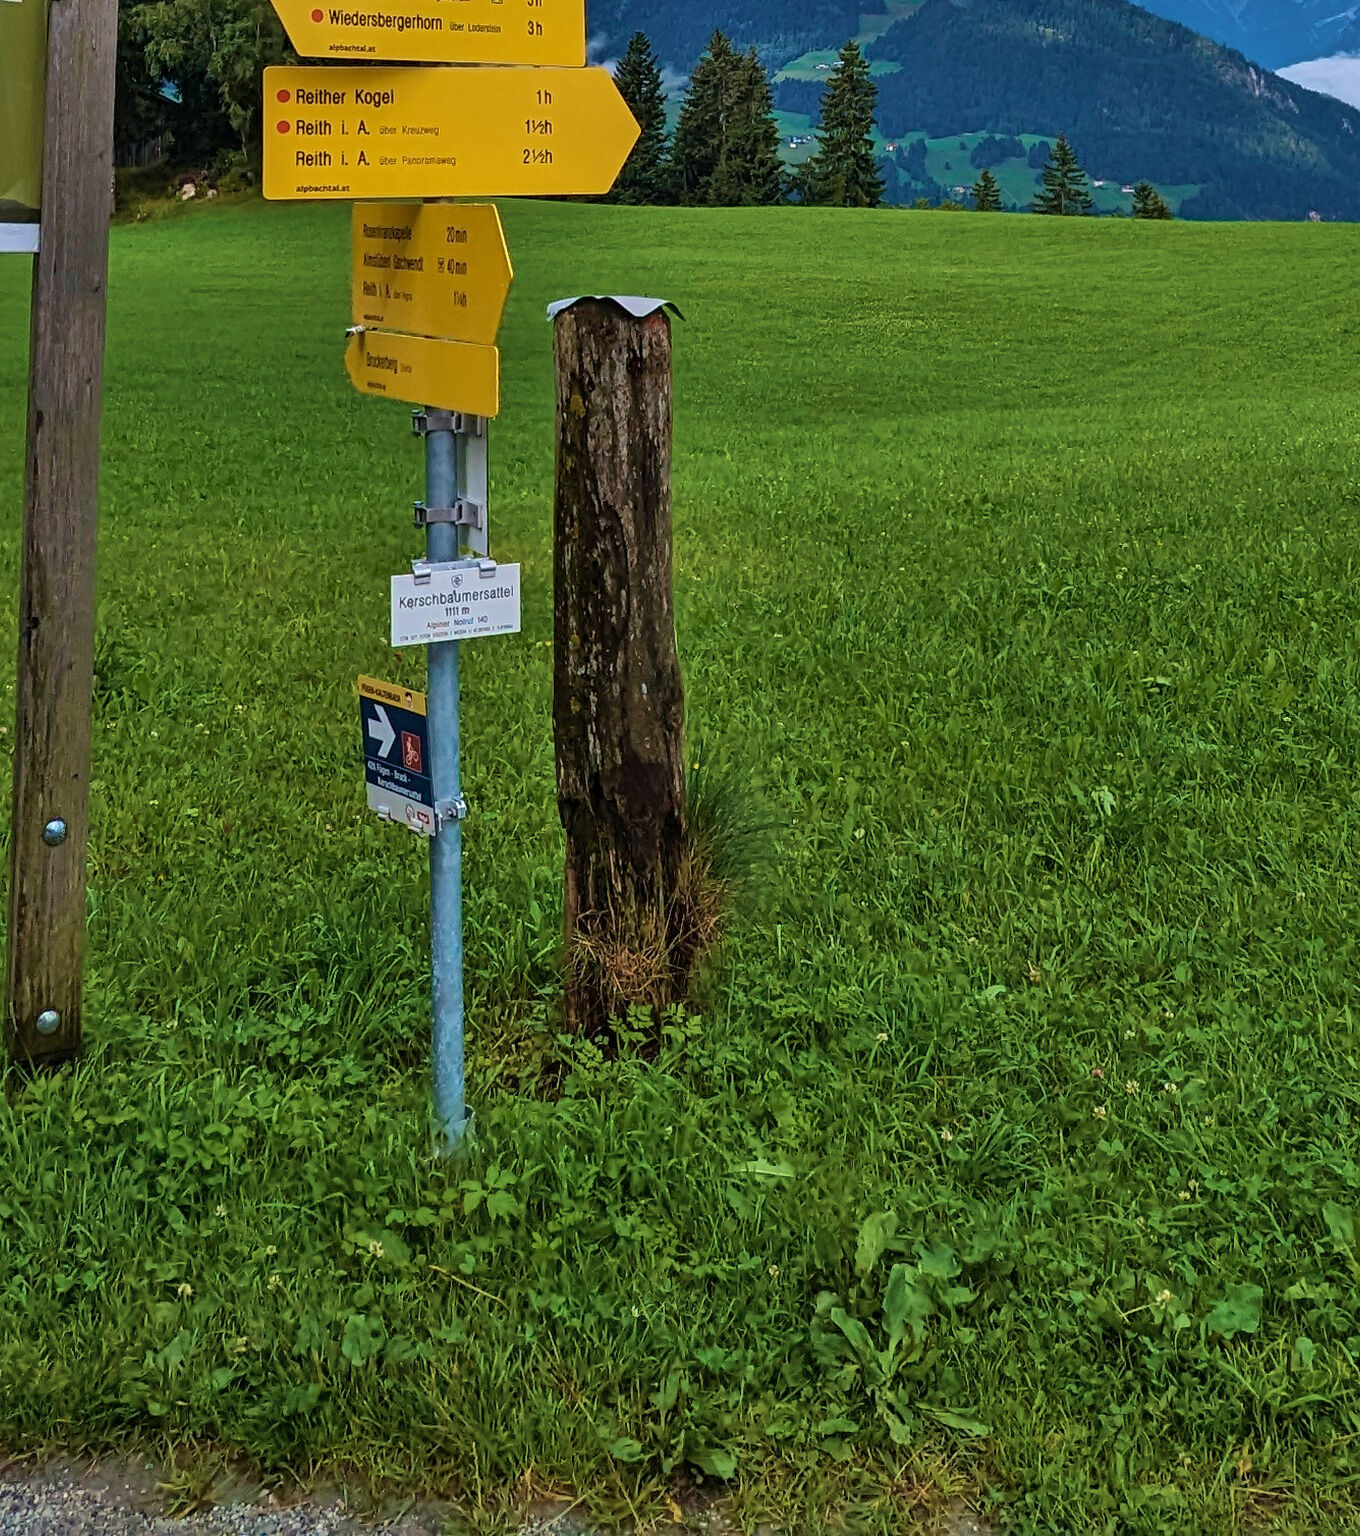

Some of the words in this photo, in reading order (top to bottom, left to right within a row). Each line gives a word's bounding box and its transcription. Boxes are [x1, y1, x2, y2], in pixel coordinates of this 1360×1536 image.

[328, 9, 443, 33] Wiedersbergerhorn
[295, 88, 347, 105] Reither
[355, 88, 395, 108] Kogel
[295, 119, 332, 136] Reith
[341, 120, 349, 136] i.
[357, 120, 371, 136] A.
[295, 150, 332, 166] Reith
[341, 150, 349, 166] i.
[357, 150, 371, 166] A.
[295, 184, 351, 194] alpbachtal.at
[399, 585, 514, 610] Kerschbaumersattel
[461, 606, 470, 615] m
